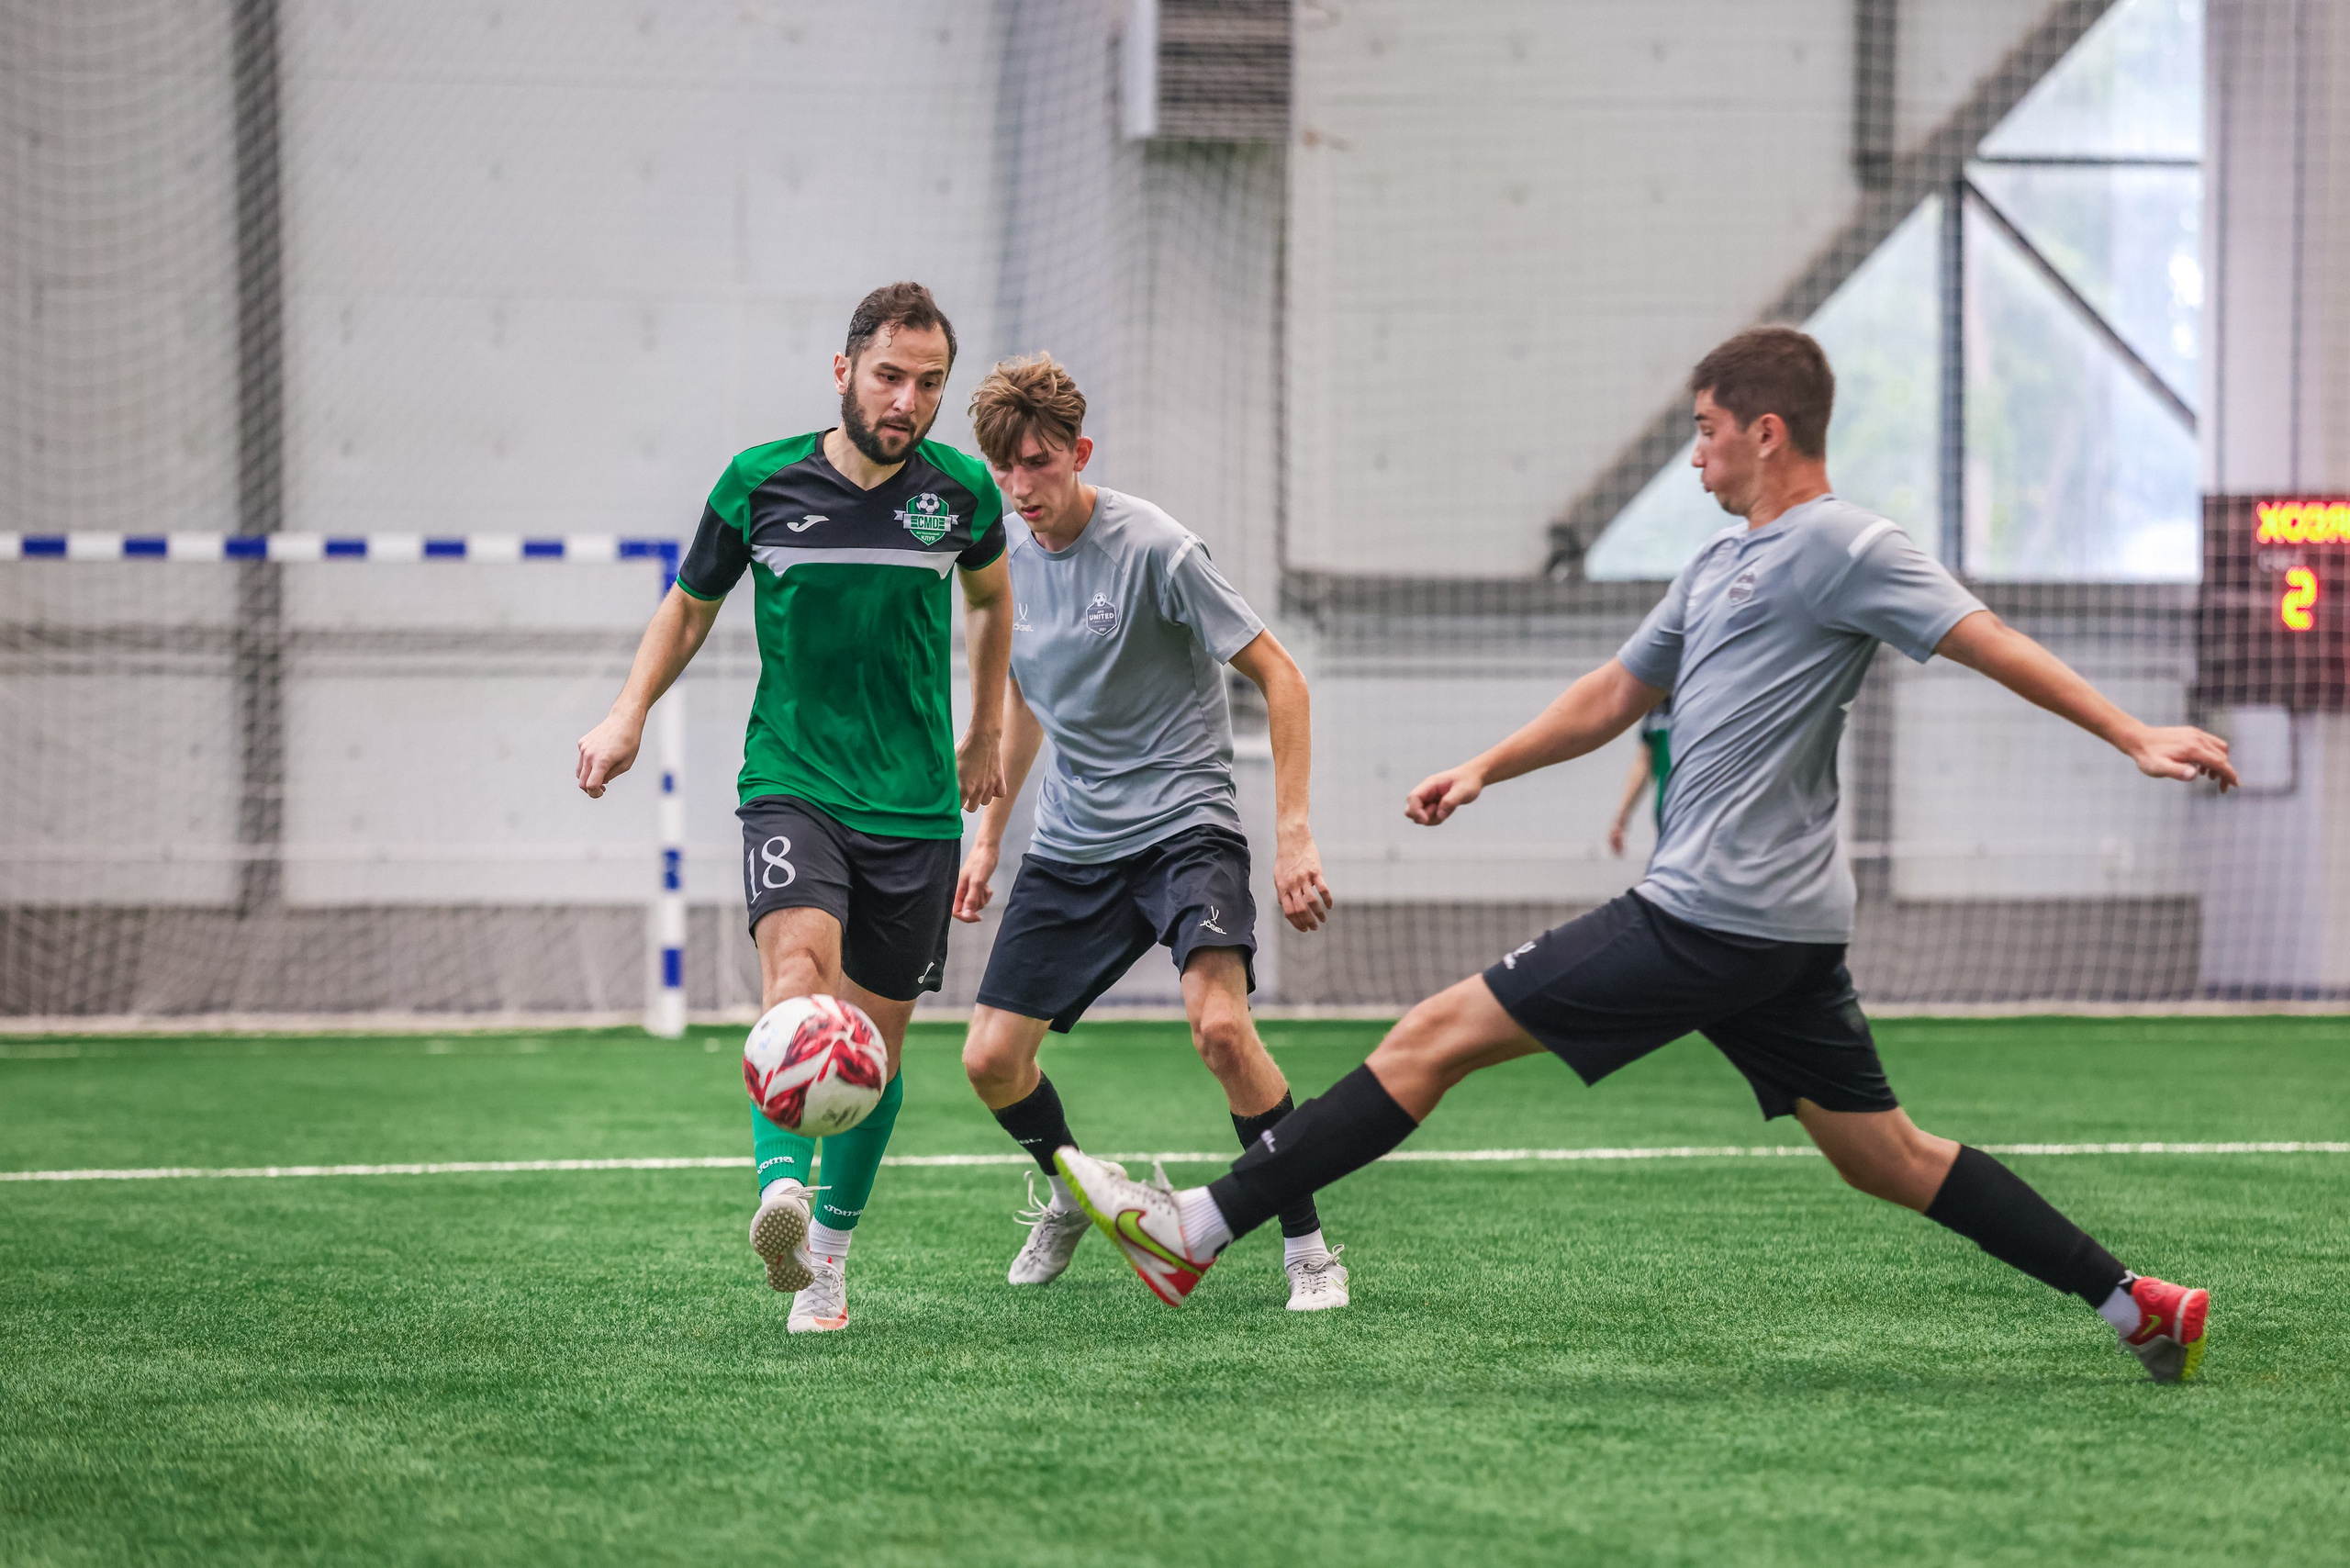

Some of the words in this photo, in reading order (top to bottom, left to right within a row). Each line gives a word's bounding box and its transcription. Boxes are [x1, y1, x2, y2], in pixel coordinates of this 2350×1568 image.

[917, 516, 939, 530] CMD
[1089, 612, 1114, 621] UNITED
[2281, 566, 2319, 631] 2
[746, 835, 797, 904] 18
